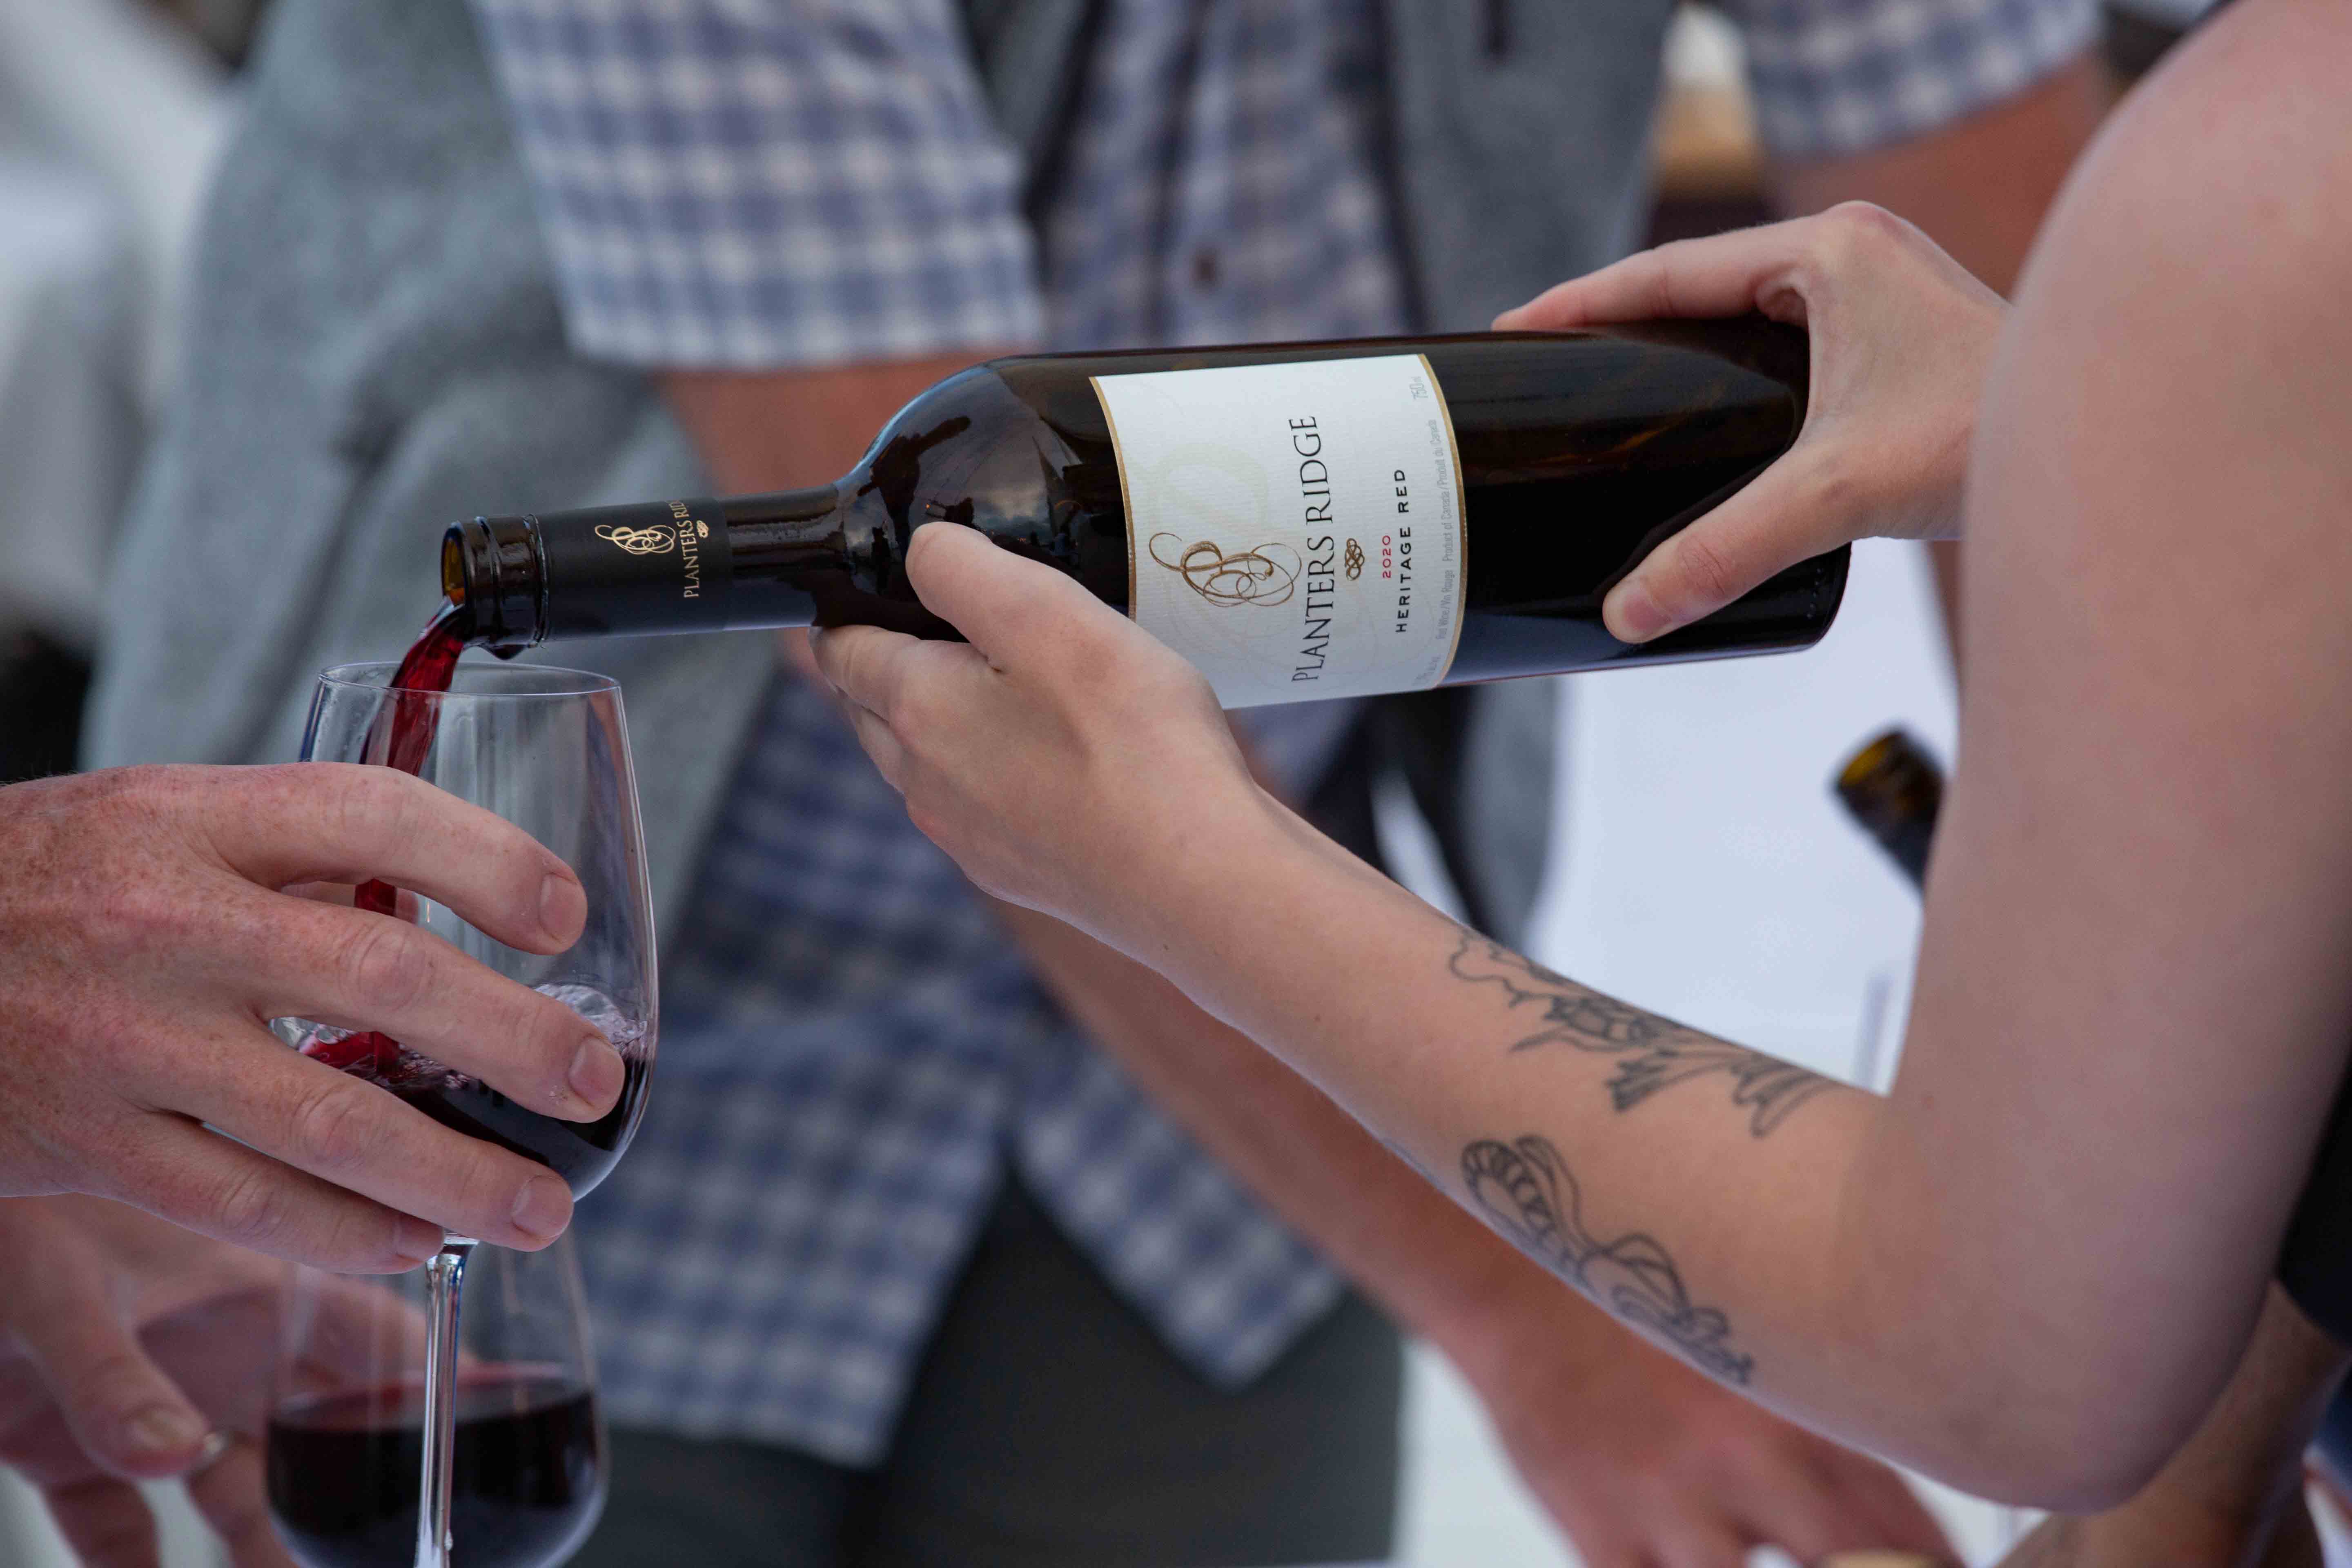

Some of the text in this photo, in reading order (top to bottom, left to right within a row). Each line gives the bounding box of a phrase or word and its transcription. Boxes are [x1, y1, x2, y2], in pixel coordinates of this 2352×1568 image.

[666, 500, 699, 598] PLANTERS RID
[1289, 415, 1335, 682] PLANTERS RIDGE
[1382, 535, 1392, 579] 2020
[1394, 469, 1412, 633] HERITAGE RED
